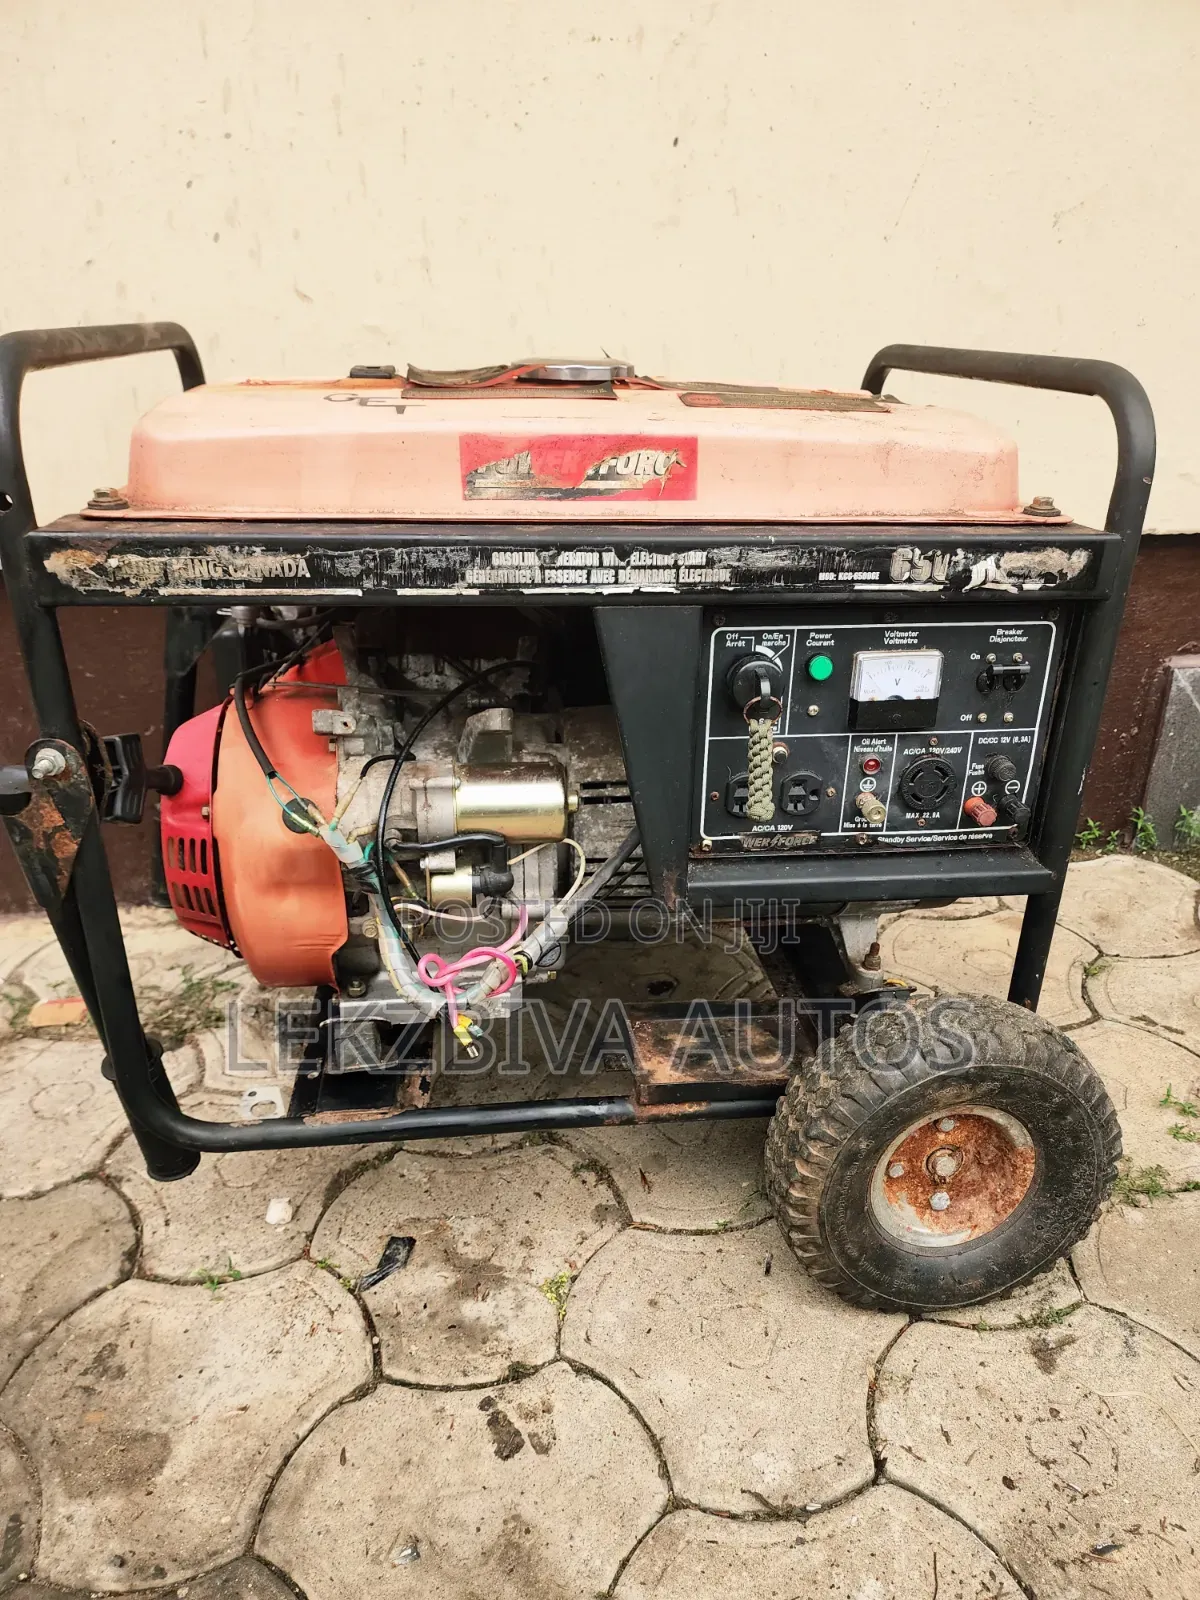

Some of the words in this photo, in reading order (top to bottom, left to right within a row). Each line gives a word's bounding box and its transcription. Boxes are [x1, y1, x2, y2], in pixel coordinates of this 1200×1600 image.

[545, 569, 588, 584] ESSENCE
[590, 569, 616, 584] AVEC
[725, 632, 739, 640] Off
[809, 632, 832, 640] Power
[884, 630, 919, 638] Voltmeter
[996, 628, 1024, 636] Breaker
[806, 639, 835, 647] Courant
[989, 635, 1028, 643] Disjoncteur
[970, 652, 981, 660] On
[894, 678, 900, 686] V
[960, 713, 973, 721] Off
[978, 737, 998, 745] DC/CC
[1000, 736, 1011, 744] 12V
[972, 762, 985, 770] Fuse
[877, 835, 905, 844] Standby
[905, 832, 958, 843] Service/Service
